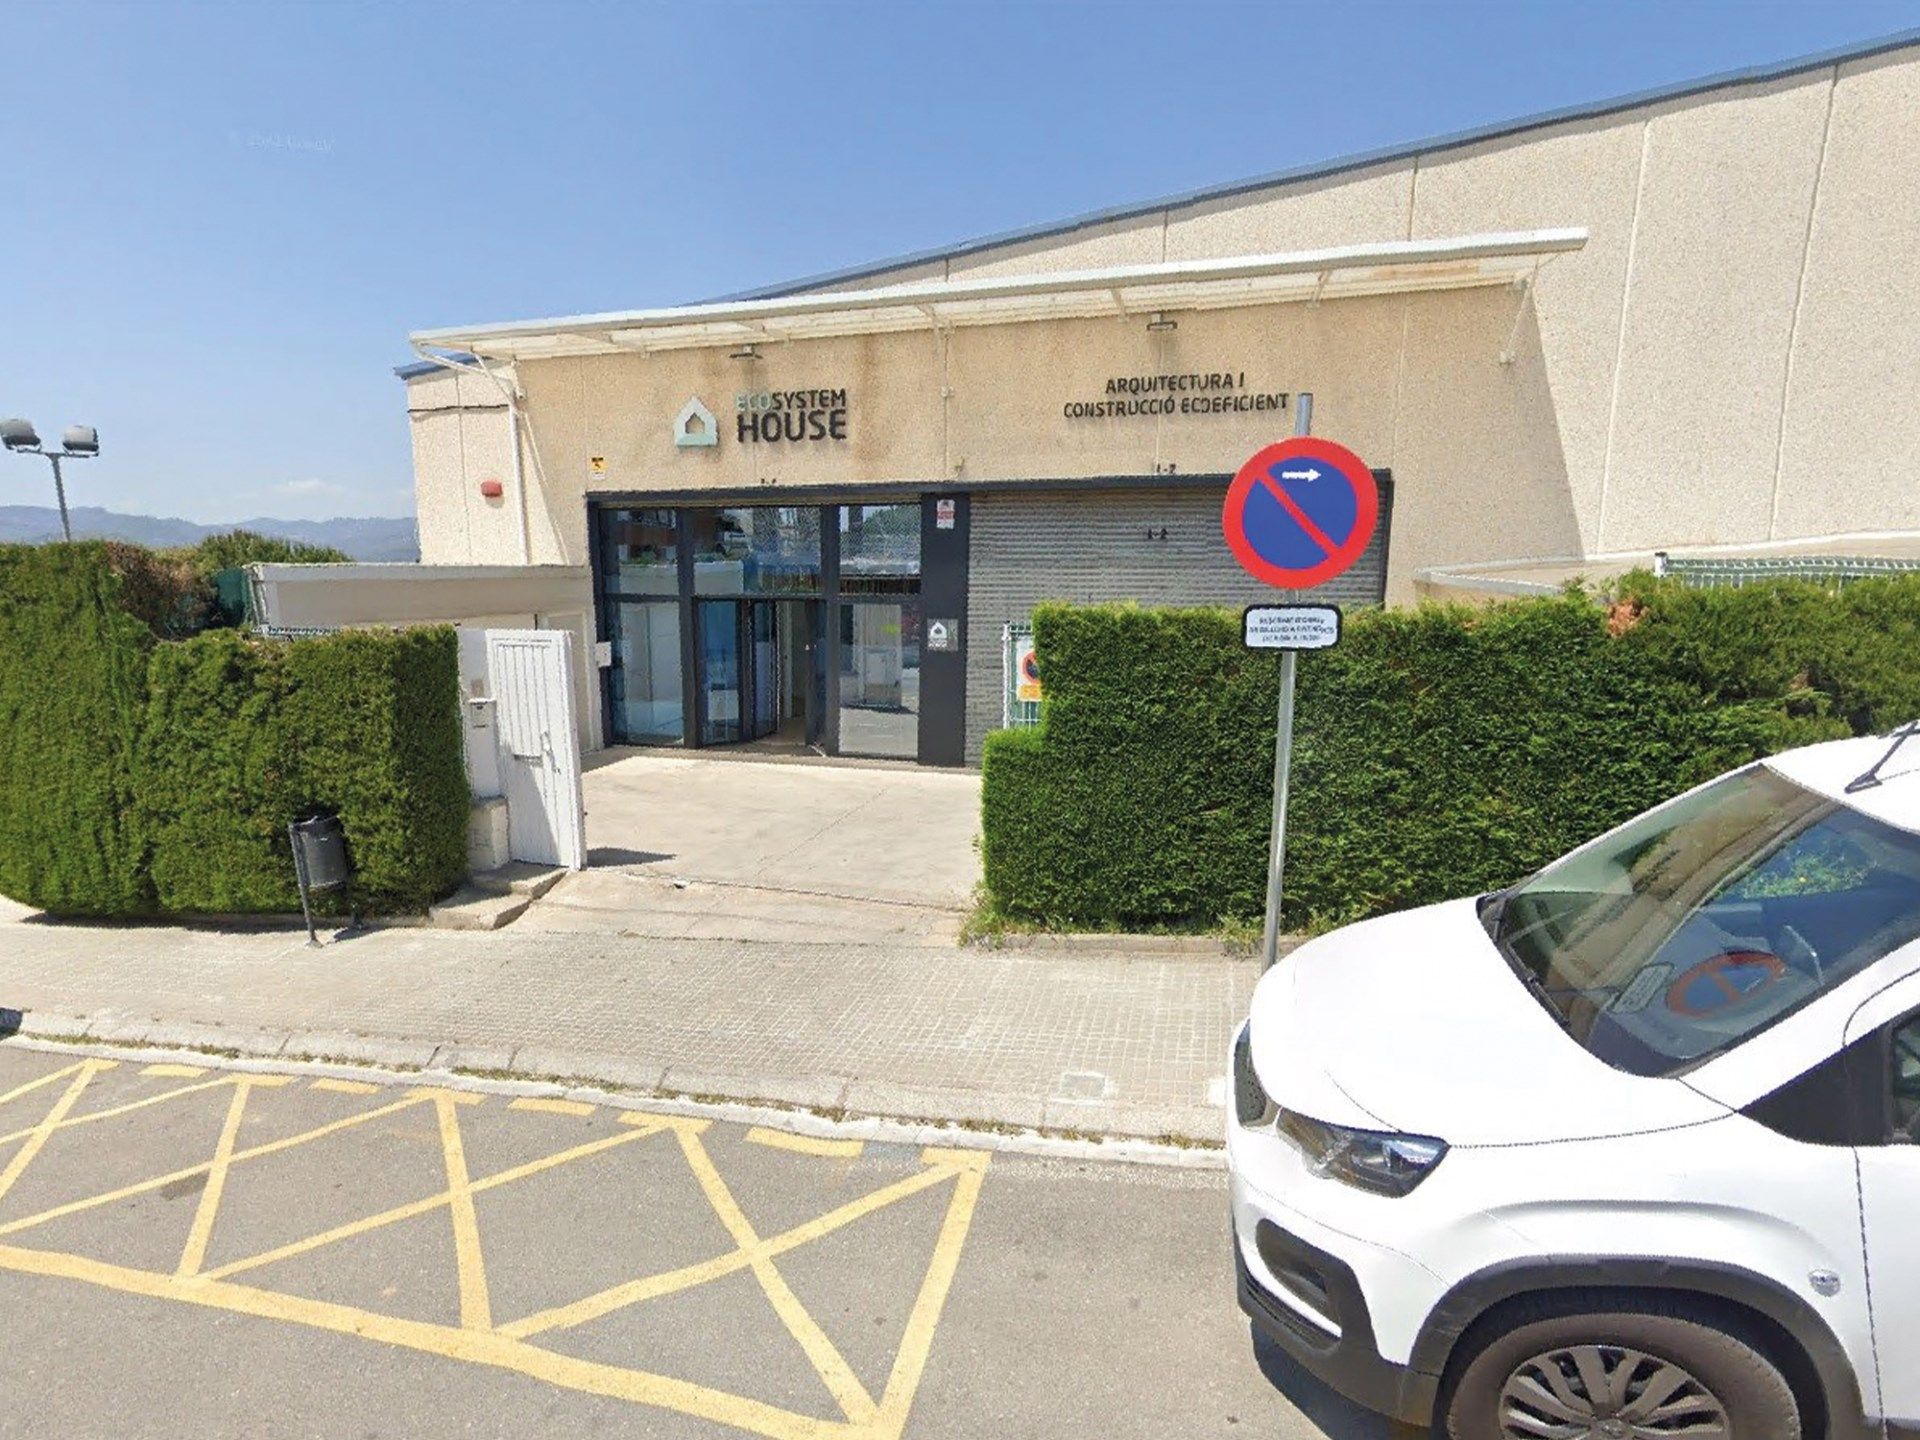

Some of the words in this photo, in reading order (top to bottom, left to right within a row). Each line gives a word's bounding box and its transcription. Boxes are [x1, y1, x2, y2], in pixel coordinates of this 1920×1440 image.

[1105, 373, 1235, 395] ARQUITECTURA
[1238, 371, 1246, 388] I
[1063, 395, 1176, 419] CONSTRUCCIÓ
[737, 409, 847, 443] HOUSE
